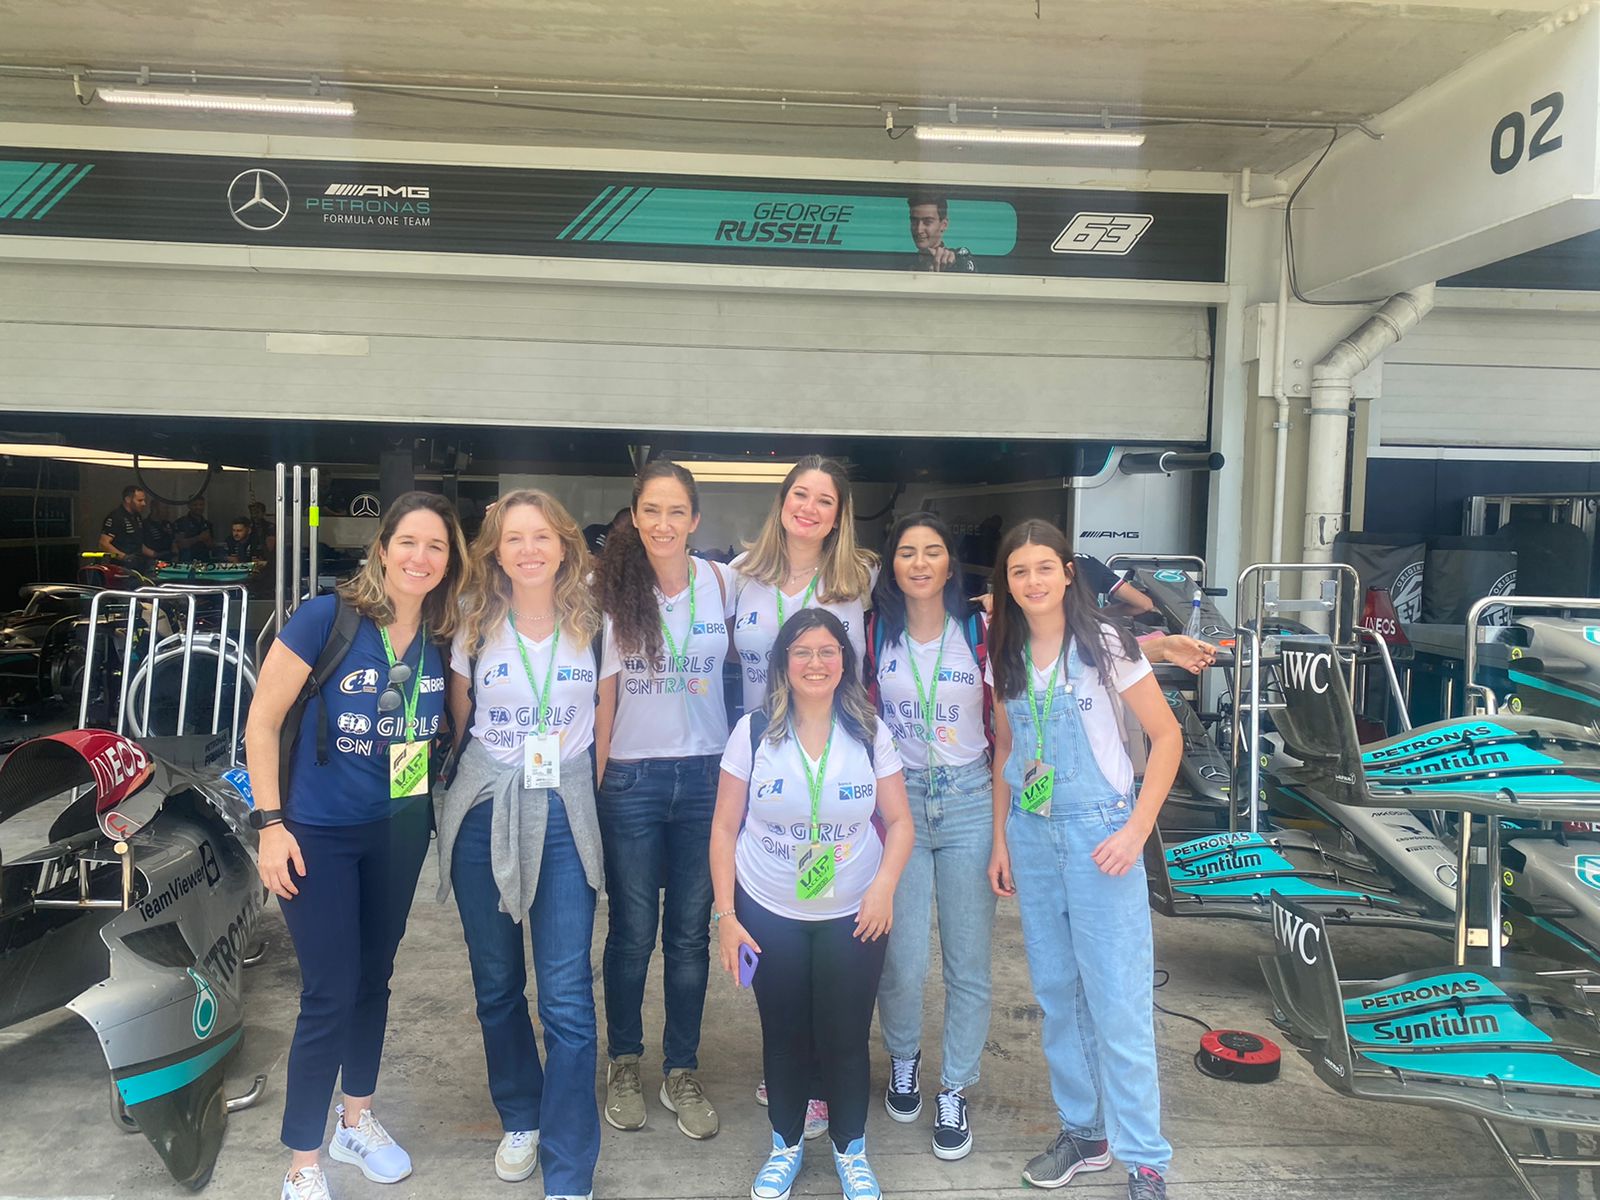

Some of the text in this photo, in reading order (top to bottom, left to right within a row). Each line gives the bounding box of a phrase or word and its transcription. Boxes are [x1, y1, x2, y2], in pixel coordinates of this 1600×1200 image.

[1491, 92, 1564, 175] 02
[350, 184, 430, 199] AMG
[306, 198, 430, 214] PETRONAS
[753, 202, 854, 223] GEORGE
[323, 214, 430, 226] FORMULA ONE TEAM
[714, 220, 843, 246] RUSSELL
[1051, 212, 1154, 255] 63
[1094, 530, 1140, 540] AMG
[707, 622, 726, 635] BRB
[1365, 616, 1396, 636] INEOS
[572, 668, 593, 683] BRB
[652, 655, 716, 674] GIRLS
[1281, 650, 1332, 695] IWC
[430, 677, 445, 693] BRB
[952, 670, 975, 686] BRB
[899, 700, 960, 723] GILS
[339, 715, 439, 737] FIA GIRLS
[1371, 726, 1491, 760] PETRONAS
[90, 738, 146, 799] INEOS
[854, 783, 874, 799] BRB
[791, 822, 861, 842] GIRLS
[1173, 832, 1250, 857] PETRONAS
[800, 855, 829, 888] VIP
[1181, 852, 1262, 878] Syntium
[135, 864, 206, 923] TeamViewer
[1271, 901, 1320, 966] IWC
[1362, 979, 1480, 1011] PETRONAS
[1374, 1012, 1500, 1044] Syntium
